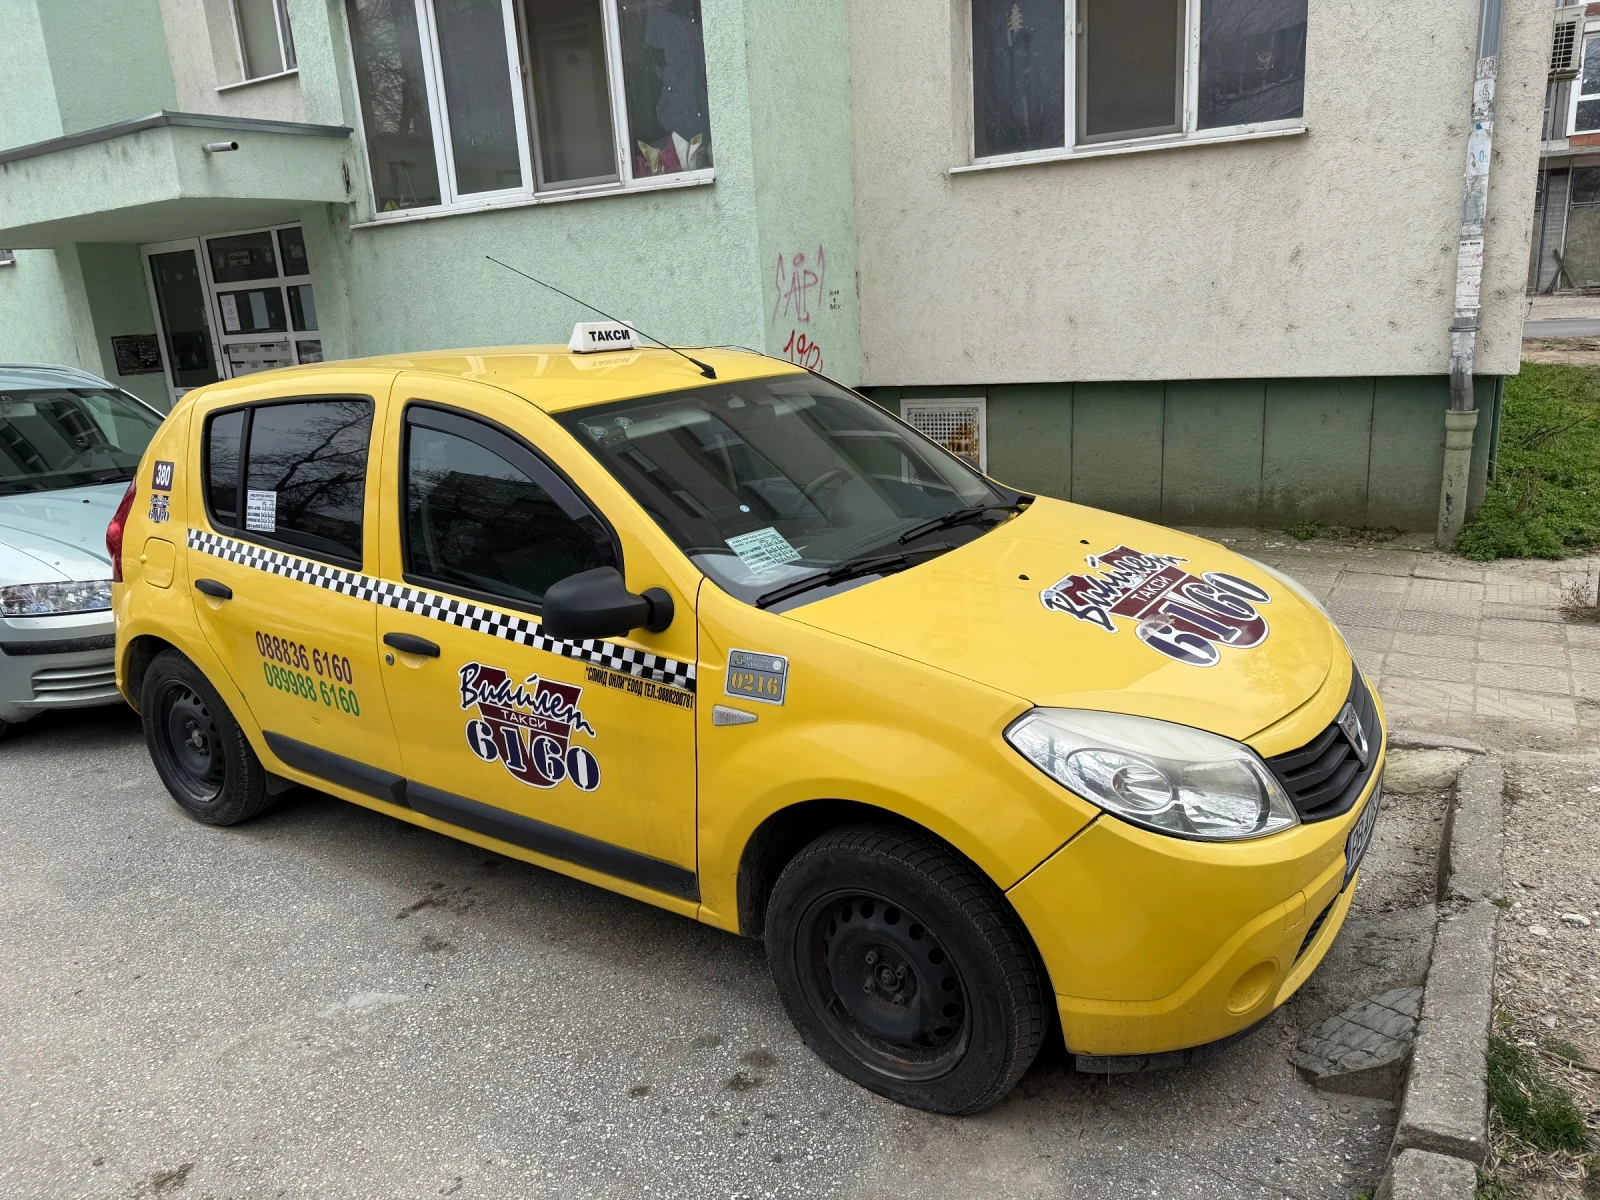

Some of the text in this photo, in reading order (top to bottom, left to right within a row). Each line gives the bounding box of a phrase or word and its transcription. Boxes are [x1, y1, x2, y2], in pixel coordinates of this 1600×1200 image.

[588, 329, 631, 342] ТАКСИ
[155, 463, 172, 487] 380
[1130, 575, 1173, 603] ТАКСИ
[1136, 571, 1272, 667] 6160
[255, 630, 353, 685] 088836 6160
[263, 661, 360, 717] 089988 6160
[731, 671, 779, 696] 0216
[501, 709, 548, 730] ТАКСИ
[466, 719, 601, 792] 6160
